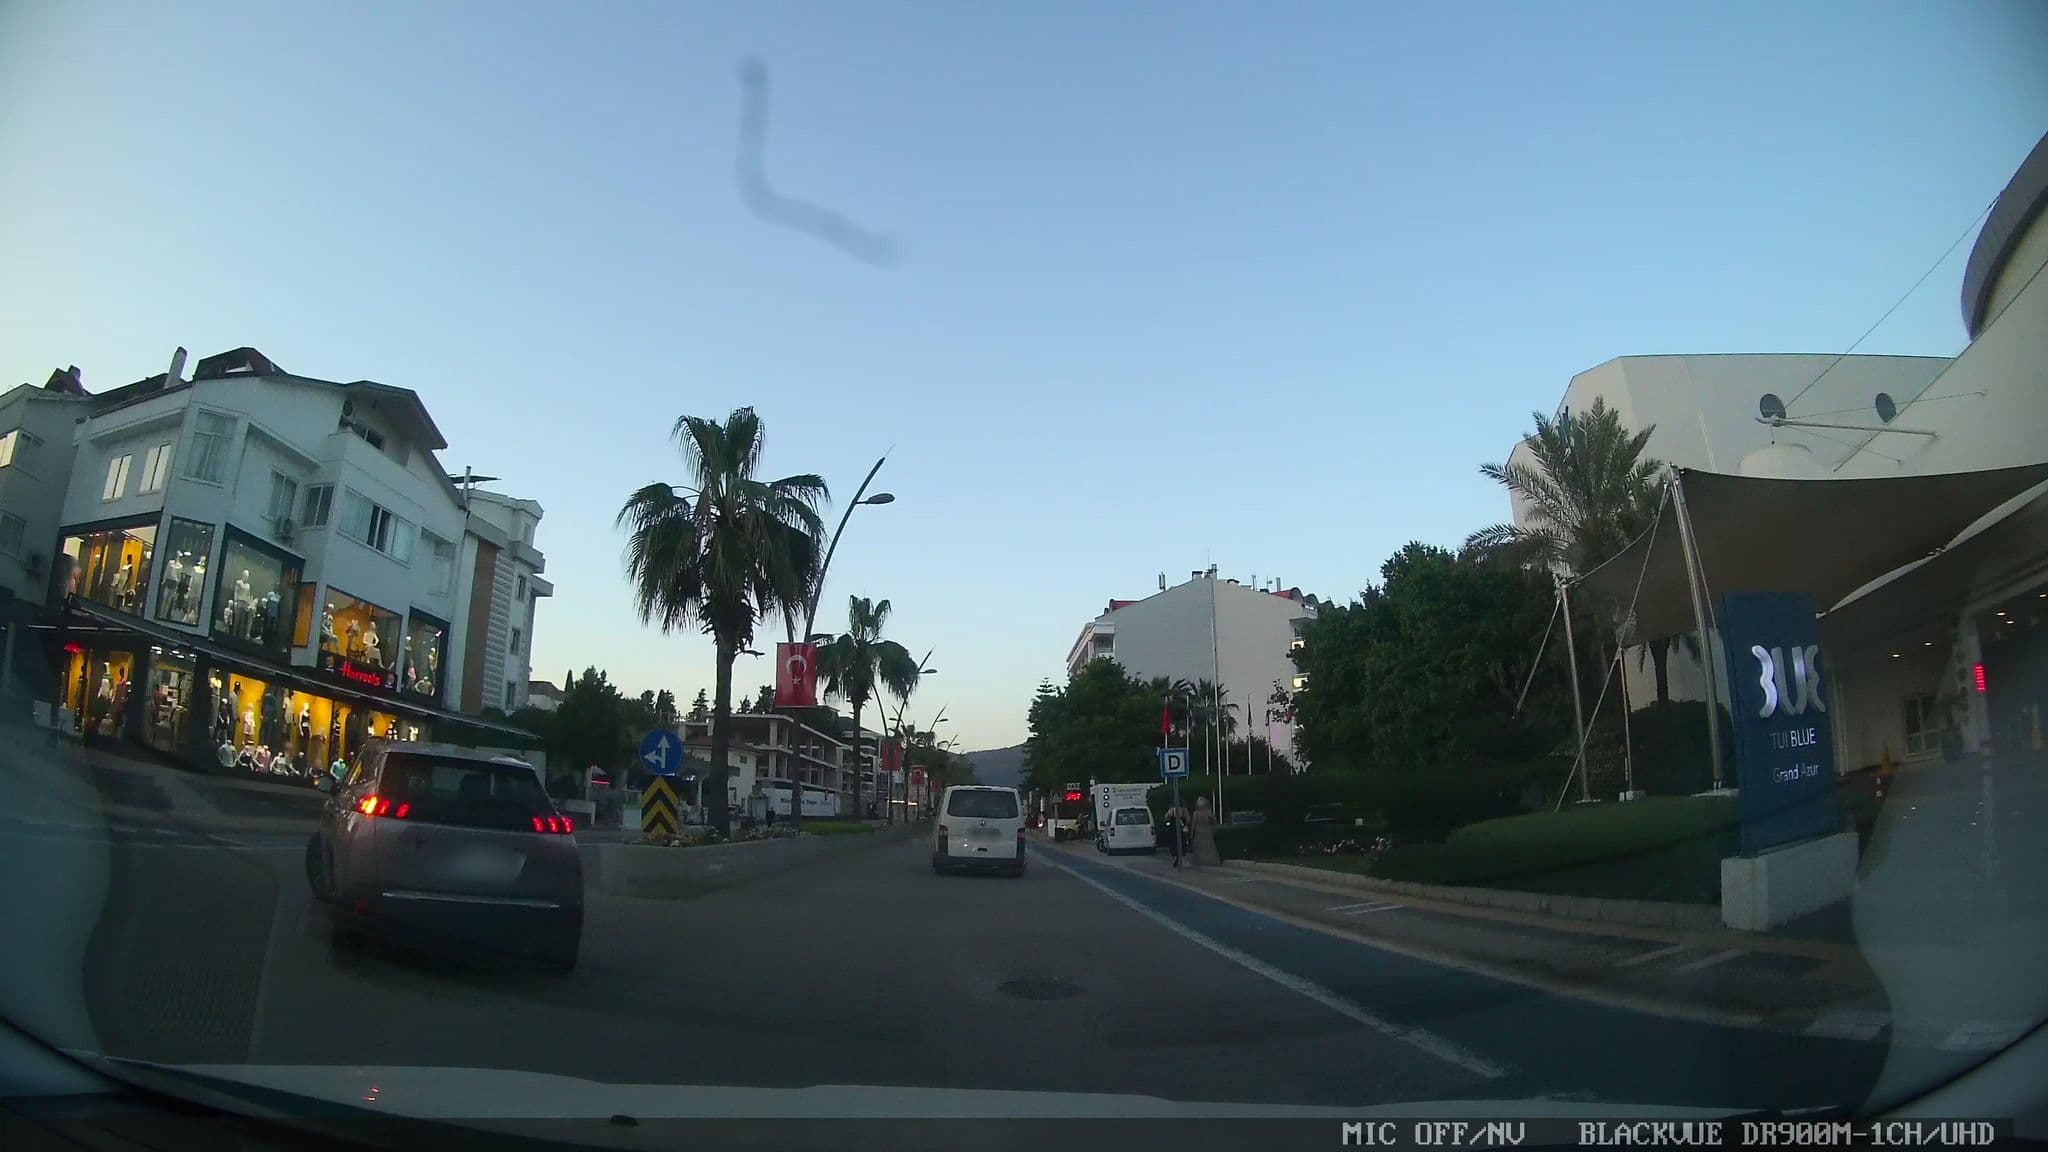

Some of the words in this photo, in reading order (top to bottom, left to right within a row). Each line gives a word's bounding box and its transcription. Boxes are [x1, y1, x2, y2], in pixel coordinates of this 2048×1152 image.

[1771, 732, 1789, 749] TUI
[1790, 727, 1816, 747] BLUE
[1168, 755, 1181, 770] D
[1773, 764, 1799, 783] Grand
[1801, 763, 1819, 777] Azur
